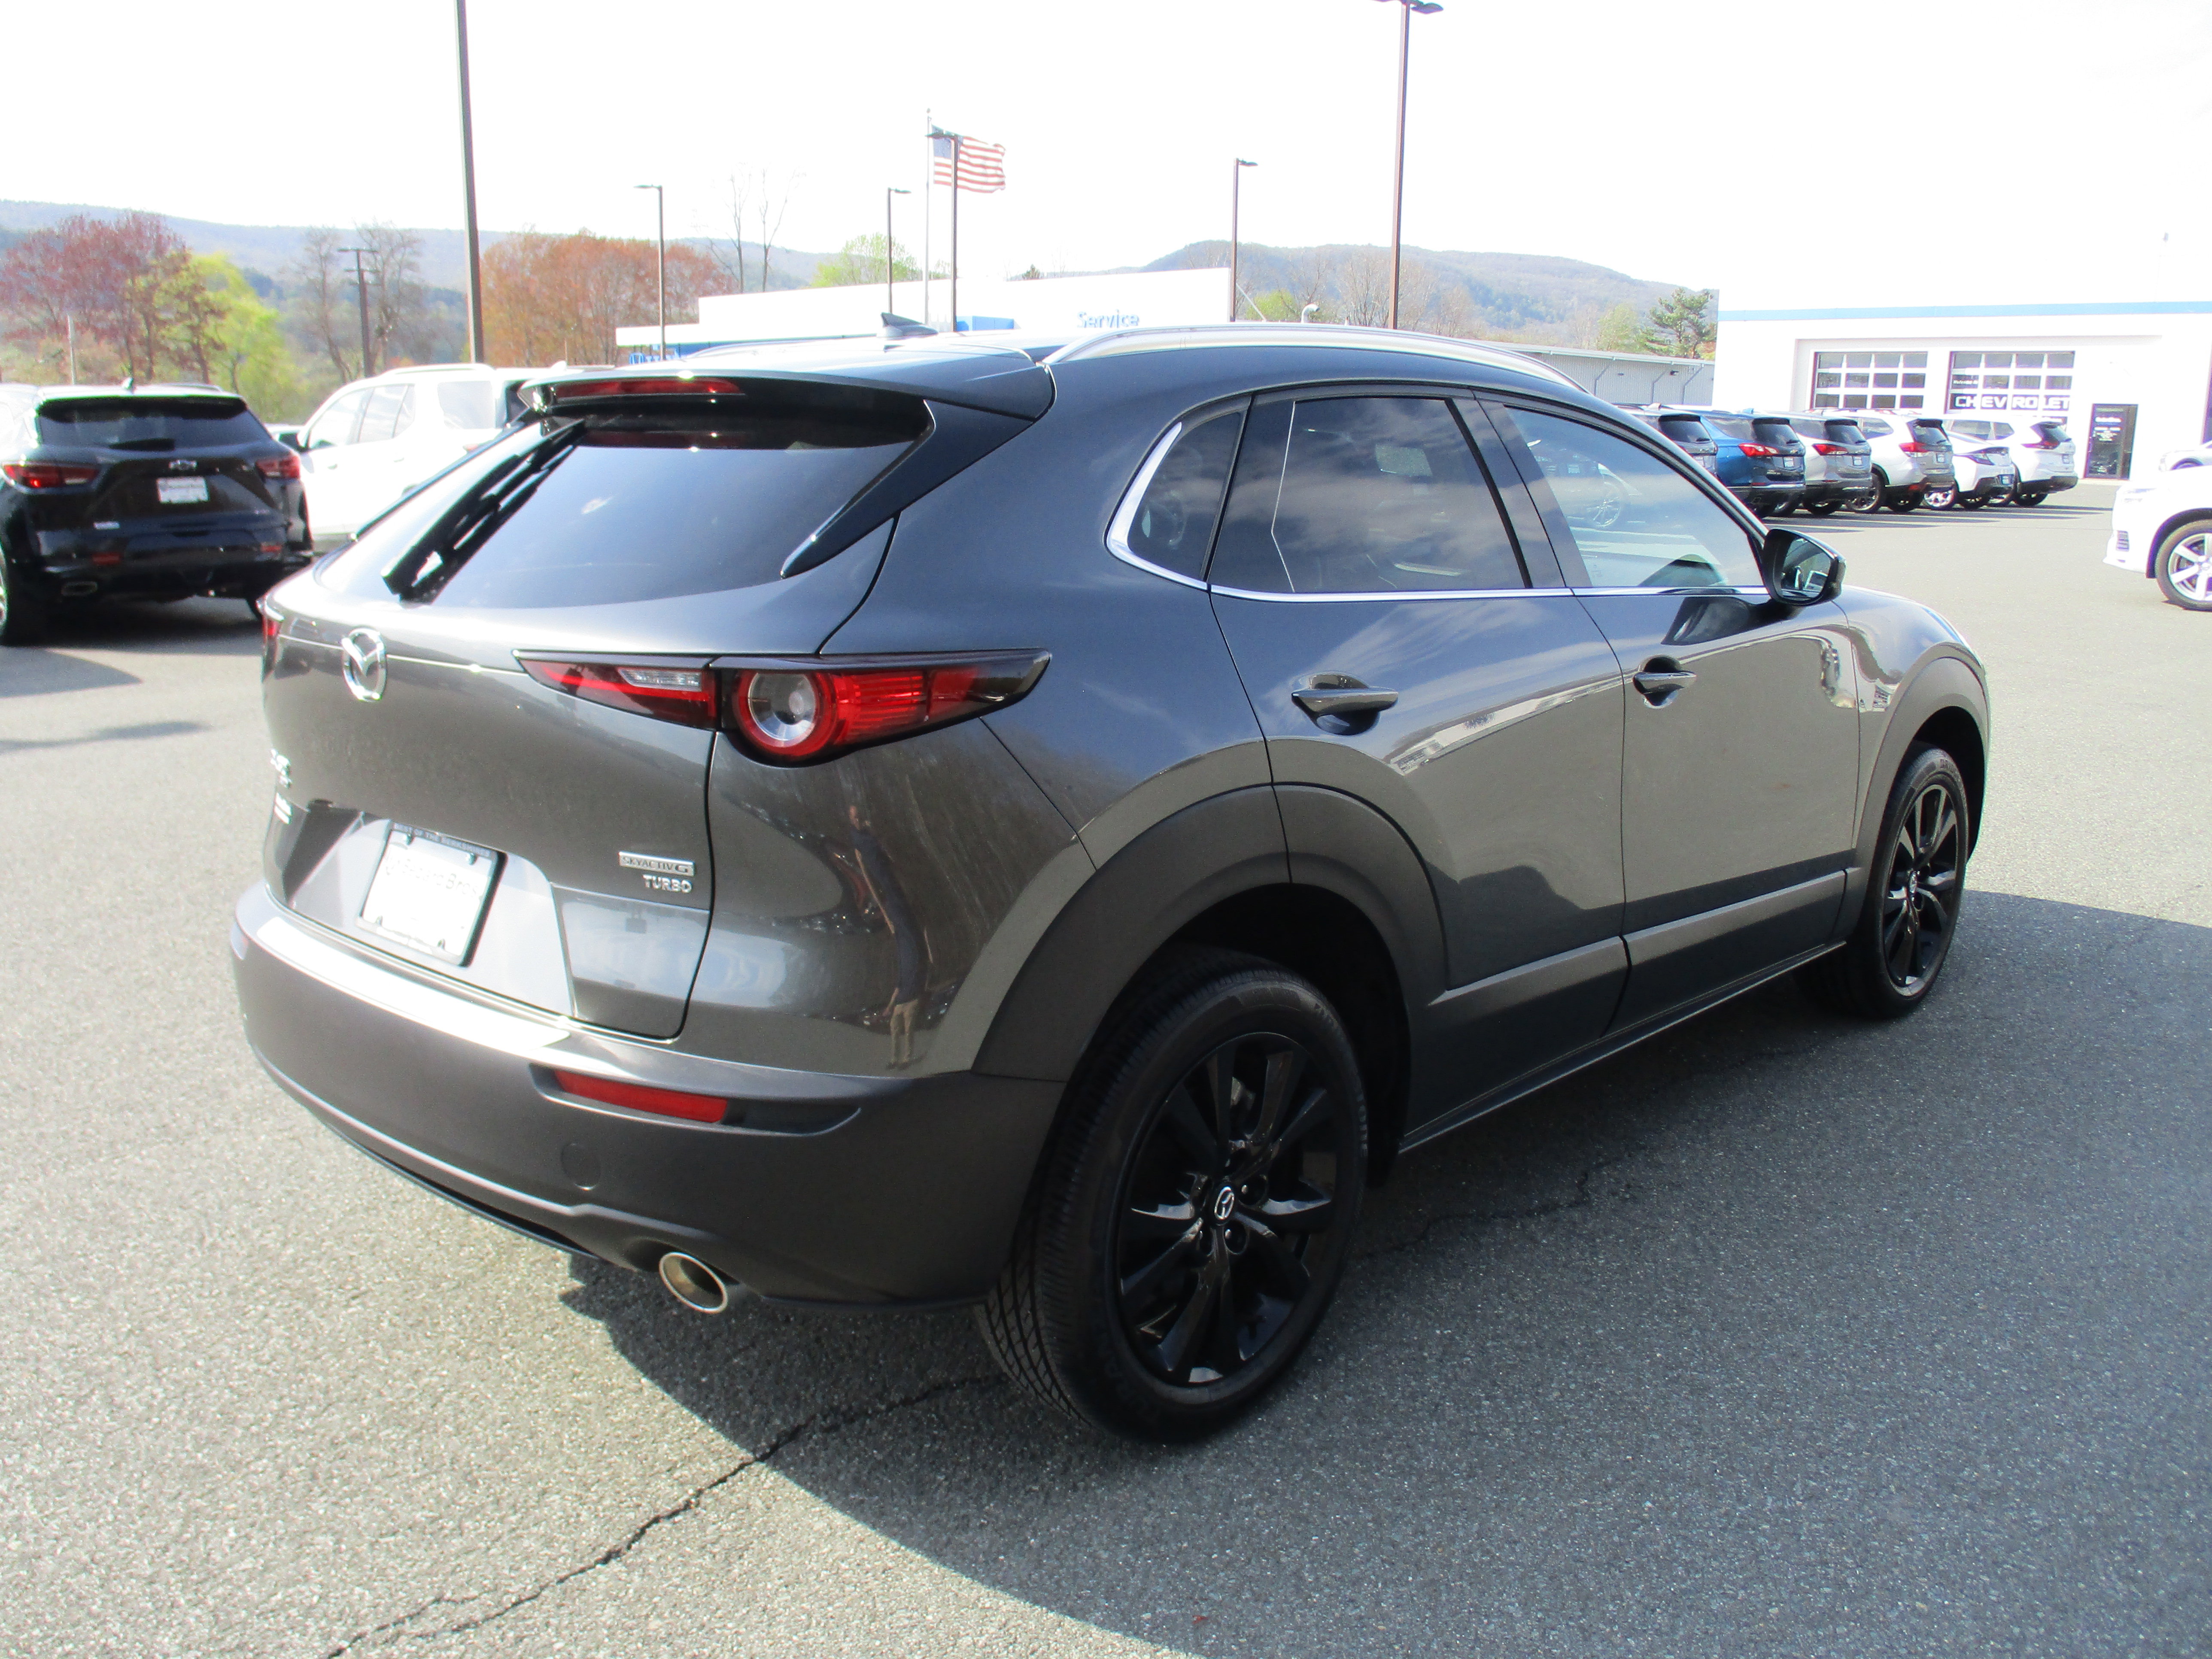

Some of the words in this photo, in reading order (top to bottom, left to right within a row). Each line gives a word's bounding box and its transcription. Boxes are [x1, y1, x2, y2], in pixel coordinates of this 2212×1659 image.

[1077, 309, 1139, 328] Service
[1955, 396, 2069, 409] CHEVROLET
[642, 874, 692, 893] TURBO
